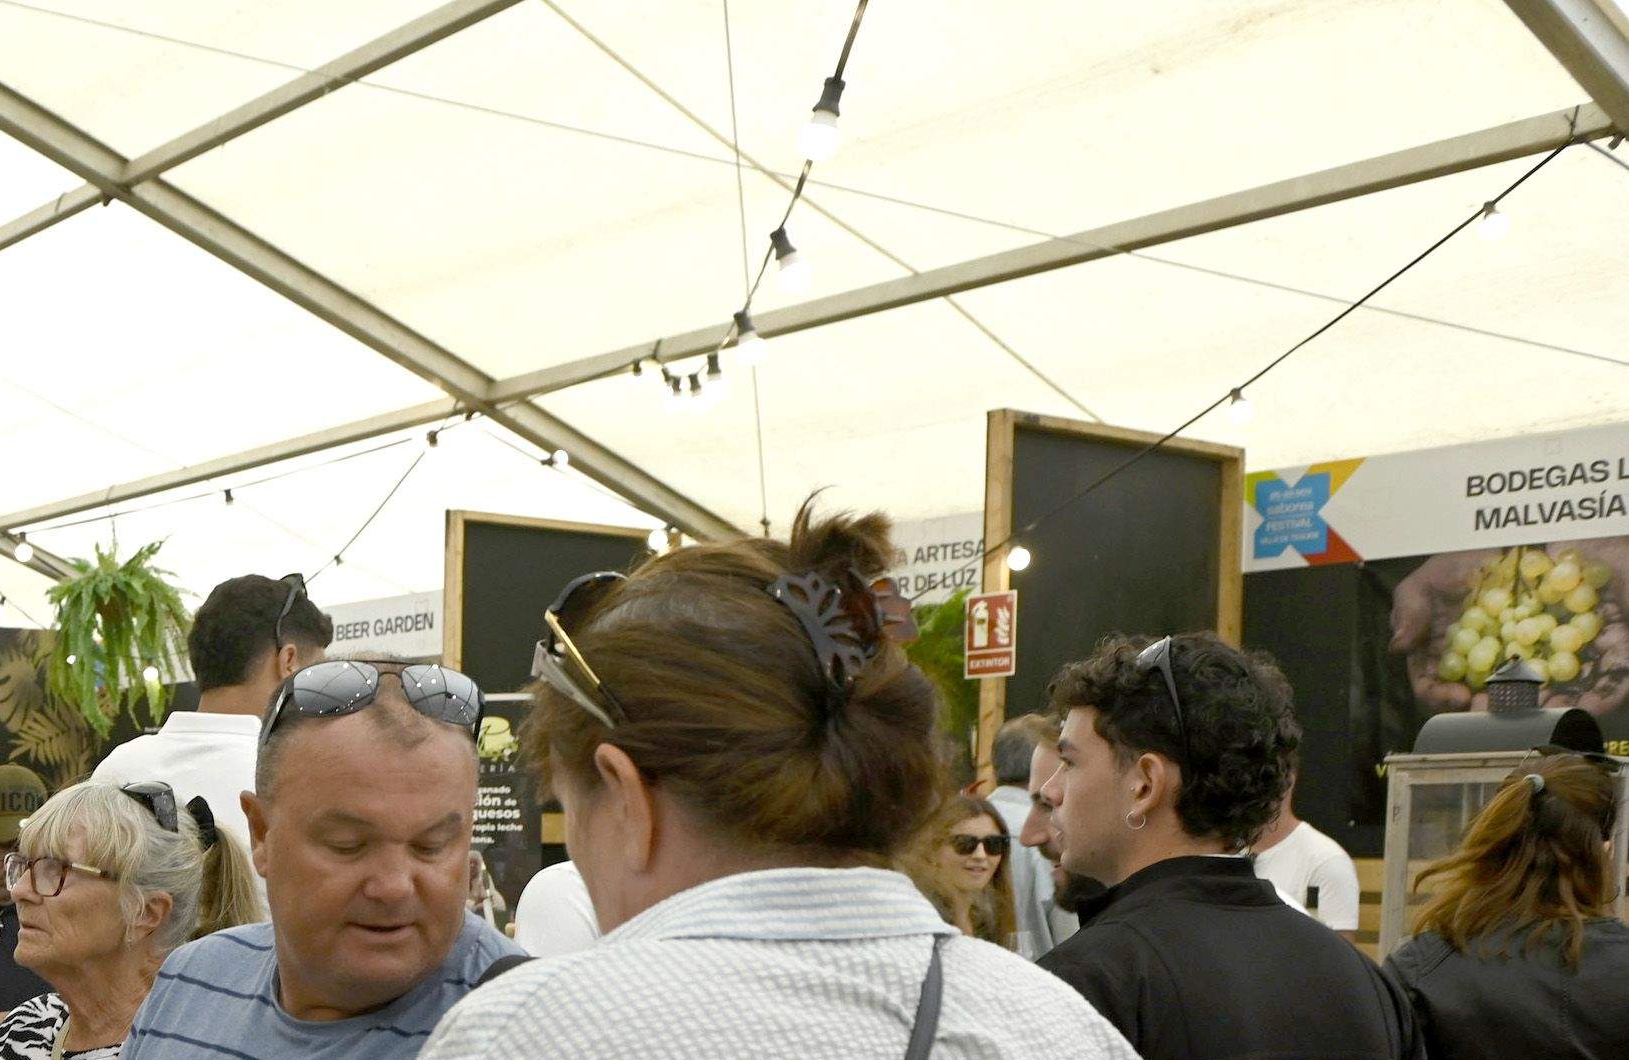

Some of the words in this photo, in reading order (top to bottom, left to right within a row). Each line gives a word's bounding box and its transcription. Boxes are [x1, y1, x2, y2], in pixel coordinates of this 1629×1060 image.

[1466, 458, 1611, 498] BODEGAS
[1474, 489, 1628, 532] MALVASÍA
[915, 571, 938, 592] DE
[943, 568, 978, 589] LUZ
[336, 621, 371, 642] BEER
[373, 612, 434, 637] GARDEN
[970, 656, 1011, 669] EXTINTOR
